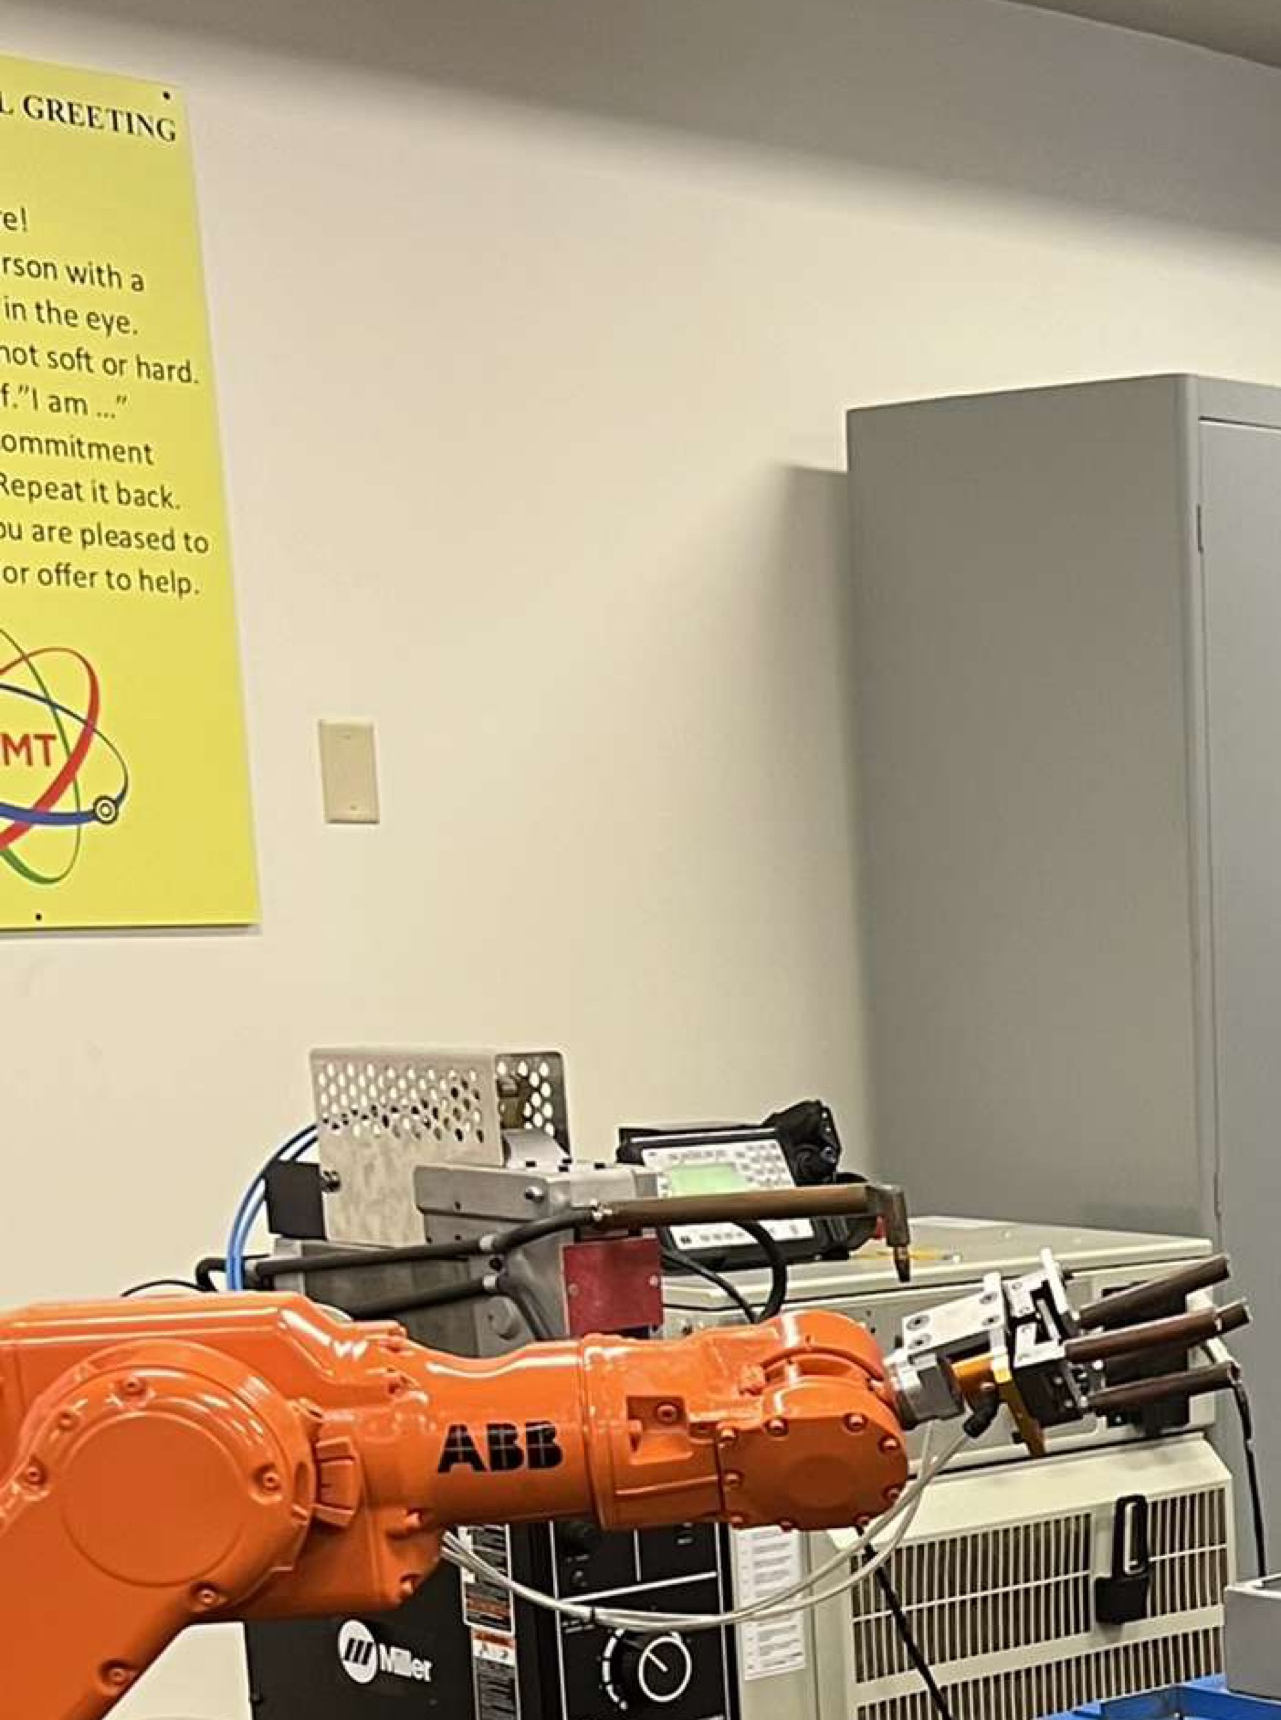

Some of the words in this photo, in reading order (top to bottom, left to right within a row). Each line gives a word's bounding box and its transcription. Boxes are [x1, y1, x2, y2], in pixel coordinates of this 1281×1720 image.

[23, 94, 176, 142] GREETING
[0, 207, 27, 232] e!
[3, 255, 57, 280] rson
[66, 262, 122, 290] with
[131, 273, 144, 292] a
[4, 296, 27, 322] in
[35, 299, 78, 327] the
[86, 311, 138, 336] eye.
[48, 347, 95, 373] soft
[102, 357, 127, 376] or
[137, 354, 200, 384] hard.
[48, 394, 88, 415] am
[1, 434, 154, 465] ommitment
[0, 472, 84, 504] Repeat
[91, 479, 109, 504] it
[117, 481, 181, 510] back.
[32, 524, 72, 543] are
[81, 522, 176, 552] pleased
[184, 533, 209, 554] to
[3, 565, 30, 584] or
[37, 563, 98, 589] offer
[105, 570, 131, 591] to
[139, 570, 200, 598] help.
[438, 1421, 563, 1473] ABB
[379, 1642, 432, 1683] Miller
